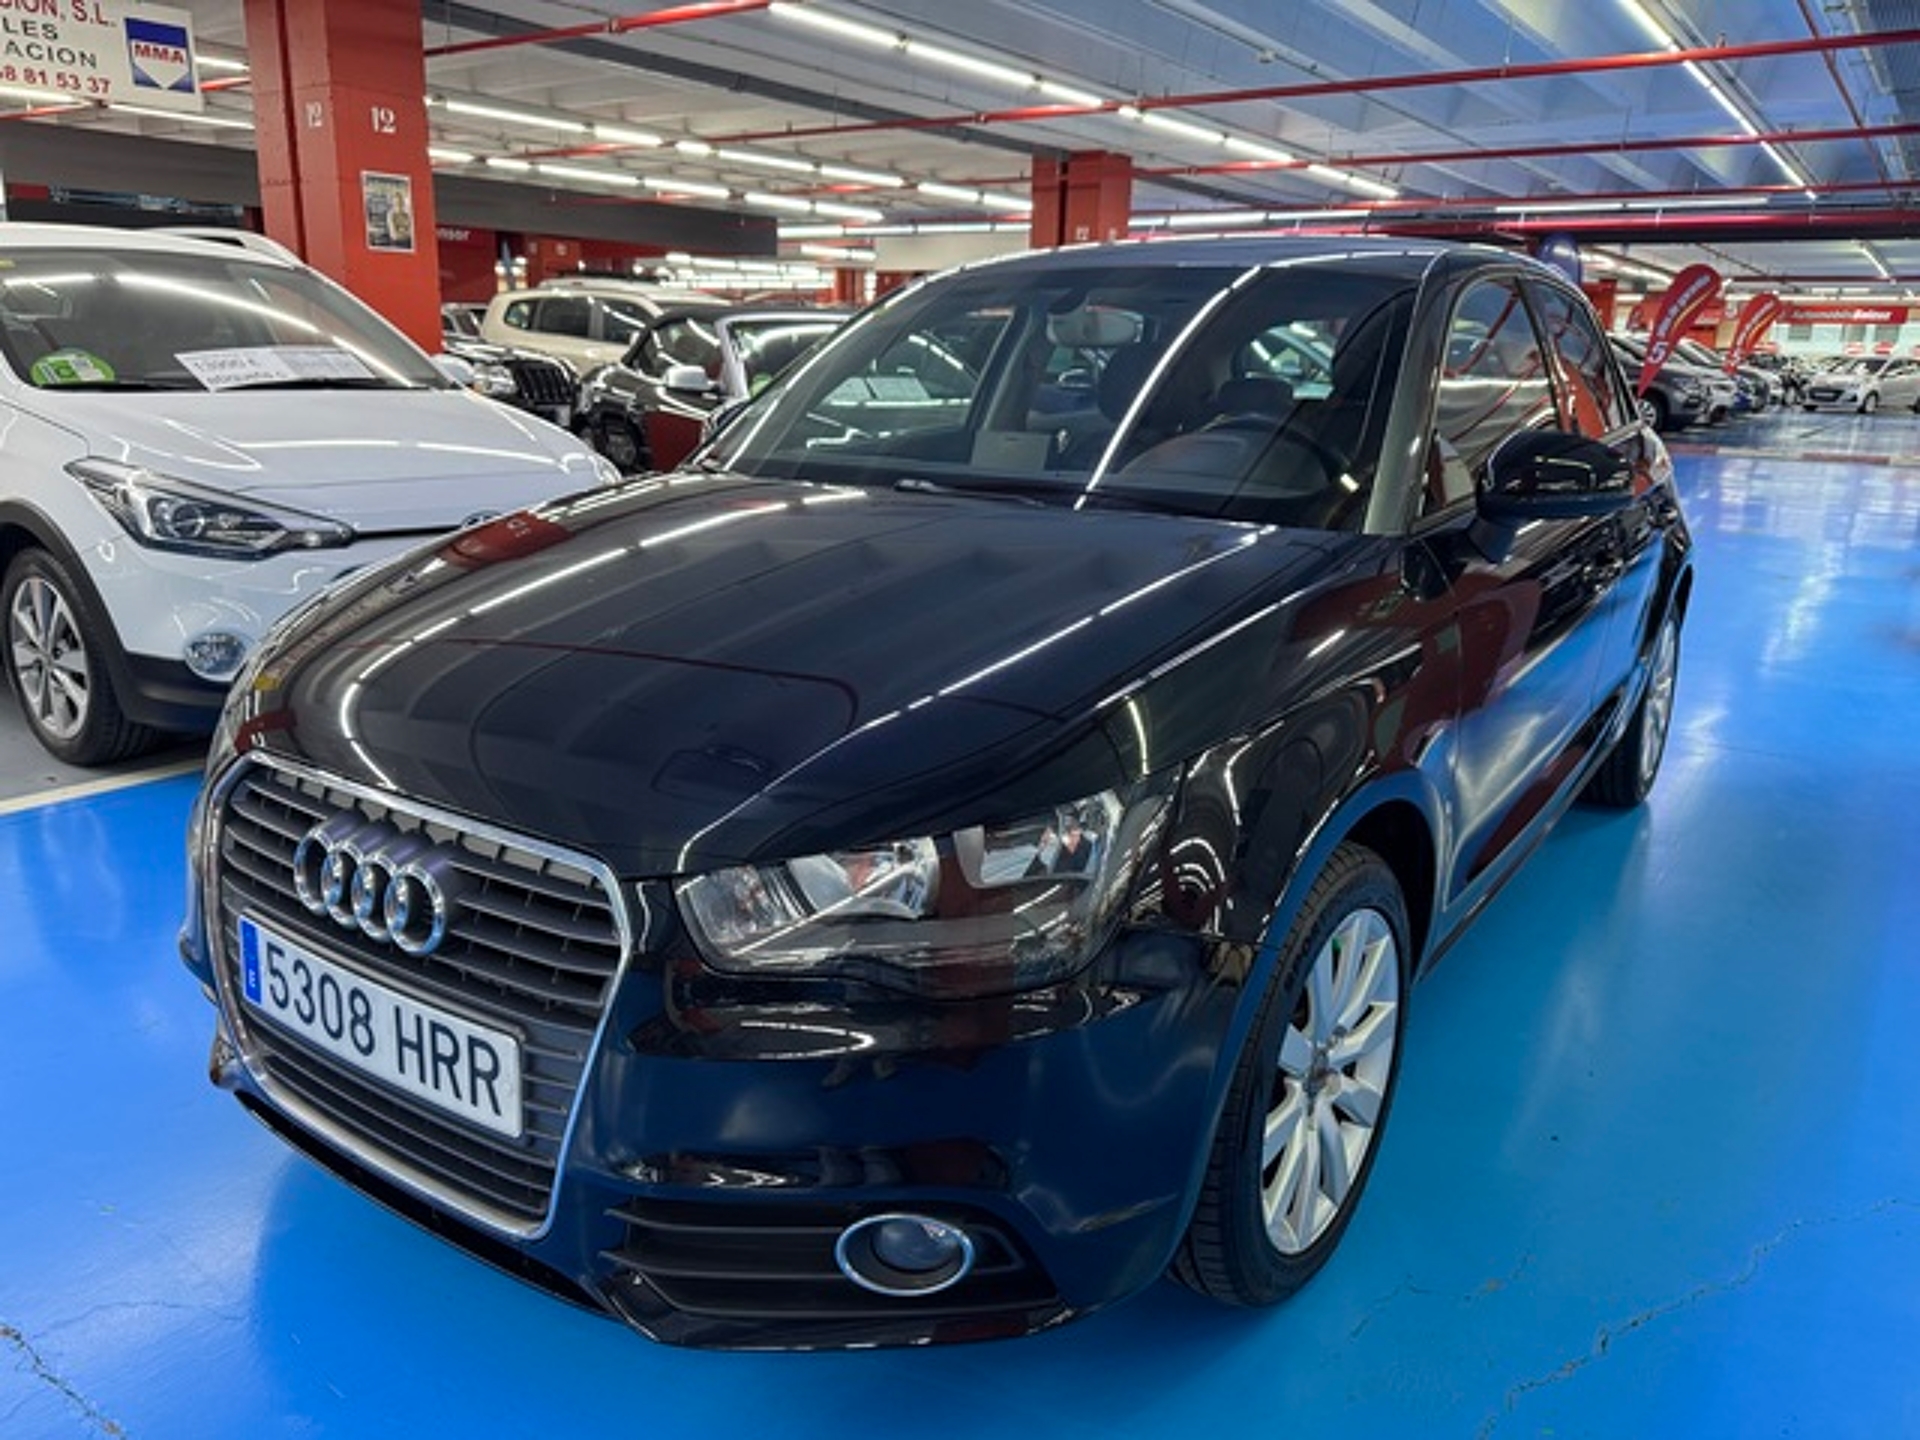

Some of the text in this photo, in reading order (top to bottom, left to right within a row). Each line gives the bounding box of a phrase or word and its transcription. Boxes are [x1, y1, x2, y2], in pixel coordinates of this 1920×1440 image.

[5, 39, 97, 69] ACION
[134, 43, 184, 64] MMA
[86, 75, 111, 93] 37
[371, 107, 396, 133] 12
[265, 941, 376, 1058] 5308
[394, 1005, 503, 1117] HRR
